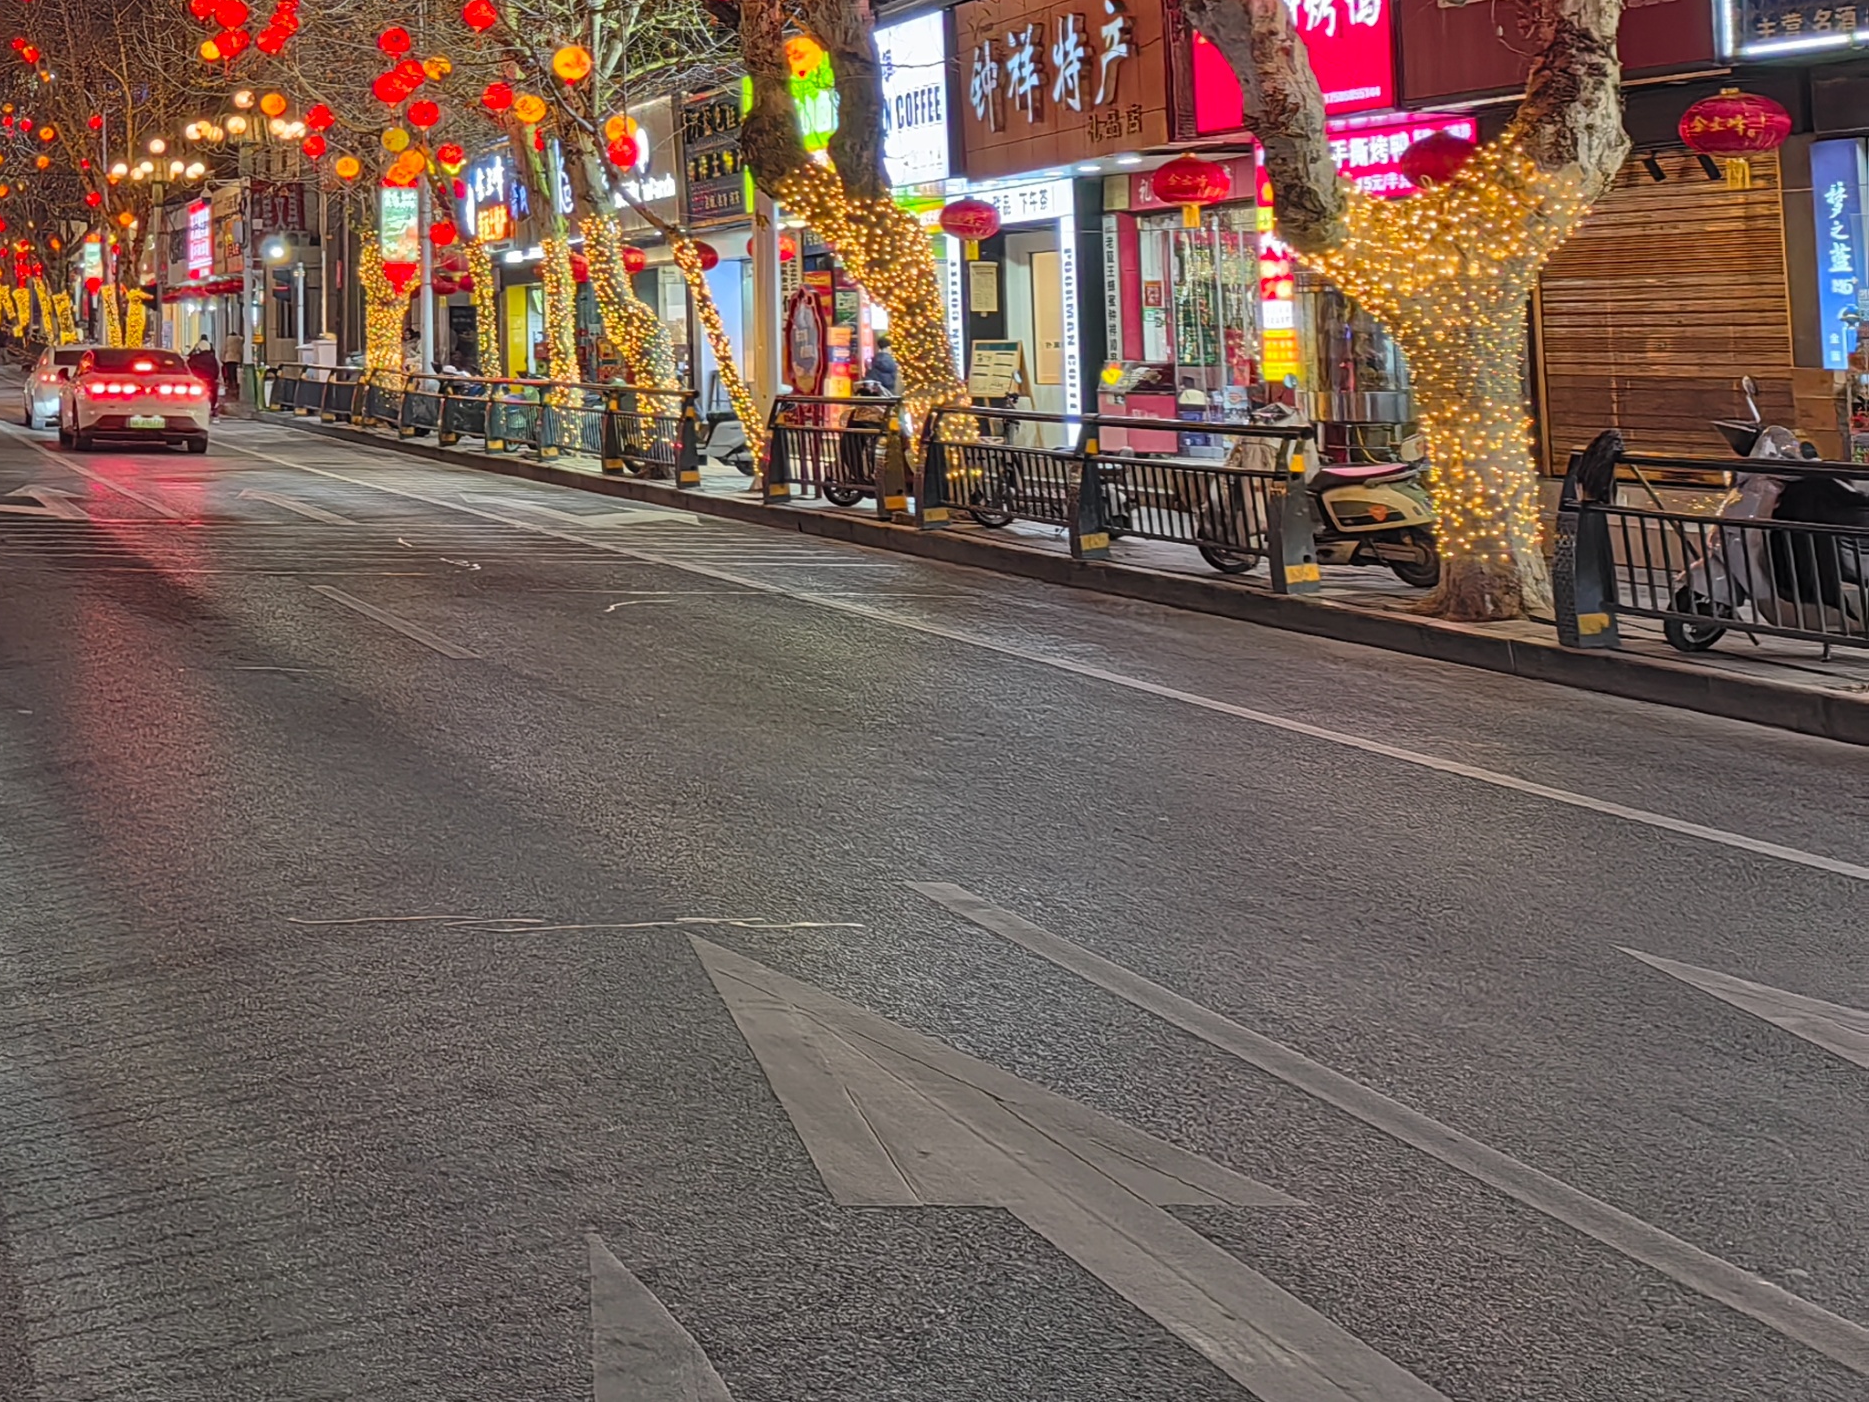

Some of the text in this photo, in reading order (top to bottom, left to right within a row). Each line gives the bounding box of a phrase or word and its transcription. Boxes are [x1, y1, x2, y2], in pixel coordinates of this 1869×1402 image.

[1757, 4, 1858, 40] 主营 名酒
[970, 0, 1129, 133] 钟祥特产
[896, 85, 942, 130] COFFEE
[1825, 181, 1854, 273] 梦之蓝
